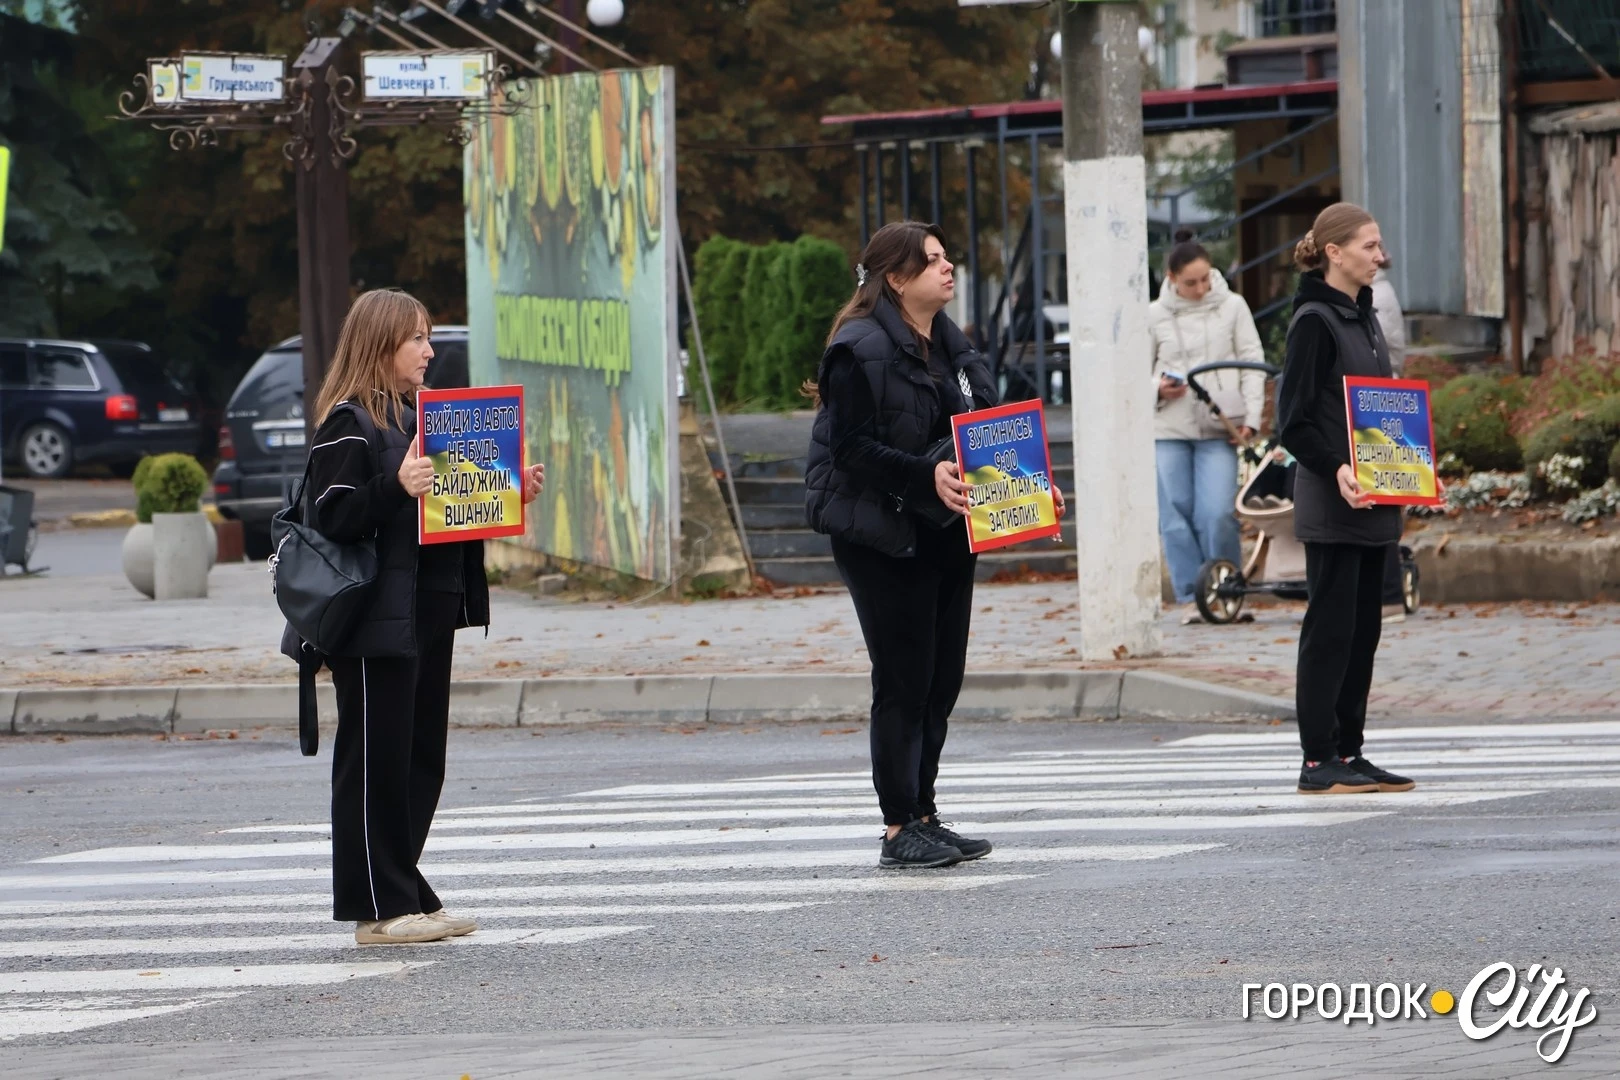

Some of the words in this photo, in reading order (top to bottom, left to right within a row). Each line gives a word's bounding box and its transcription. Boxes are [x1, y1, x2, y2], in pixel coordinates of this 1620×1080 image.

[231, 63, 254, 73] улиця
[209, 76, 274, 93] Грушевського
[379, 76, 435, 91] Шевченка
[440, 76, 450, 91] Т.
[1358, 390, 1419, 414] ЗУПИНИСЬ!
[425, 404, 471, 437] ВИЙДИ
[484, 406, 519, 431] АВТО!
[1381, 418, 1403, 440] 9:00
[968, 416, 1033, 450] ЗУПИНИСЬ!
[447, 441, 465, 464] НЕ
[468, 438, 500, 466] БУДЬ
[994, 449, 1018, 473] 9:00
[1356, 441, 1395, 464] ВШАНУЙ
[433, 467, 511, 498] БАЙДУЖИМ!
[969, 475, 1010, 508] ВШАНУЙ
[1373, 470, 1420, 490] ЗАГИБЛИХ!
[445, 495, 503, 527] ВШАНУЙ!
[989, 503, 1040, 533] ЗАГИБЛИХ!
